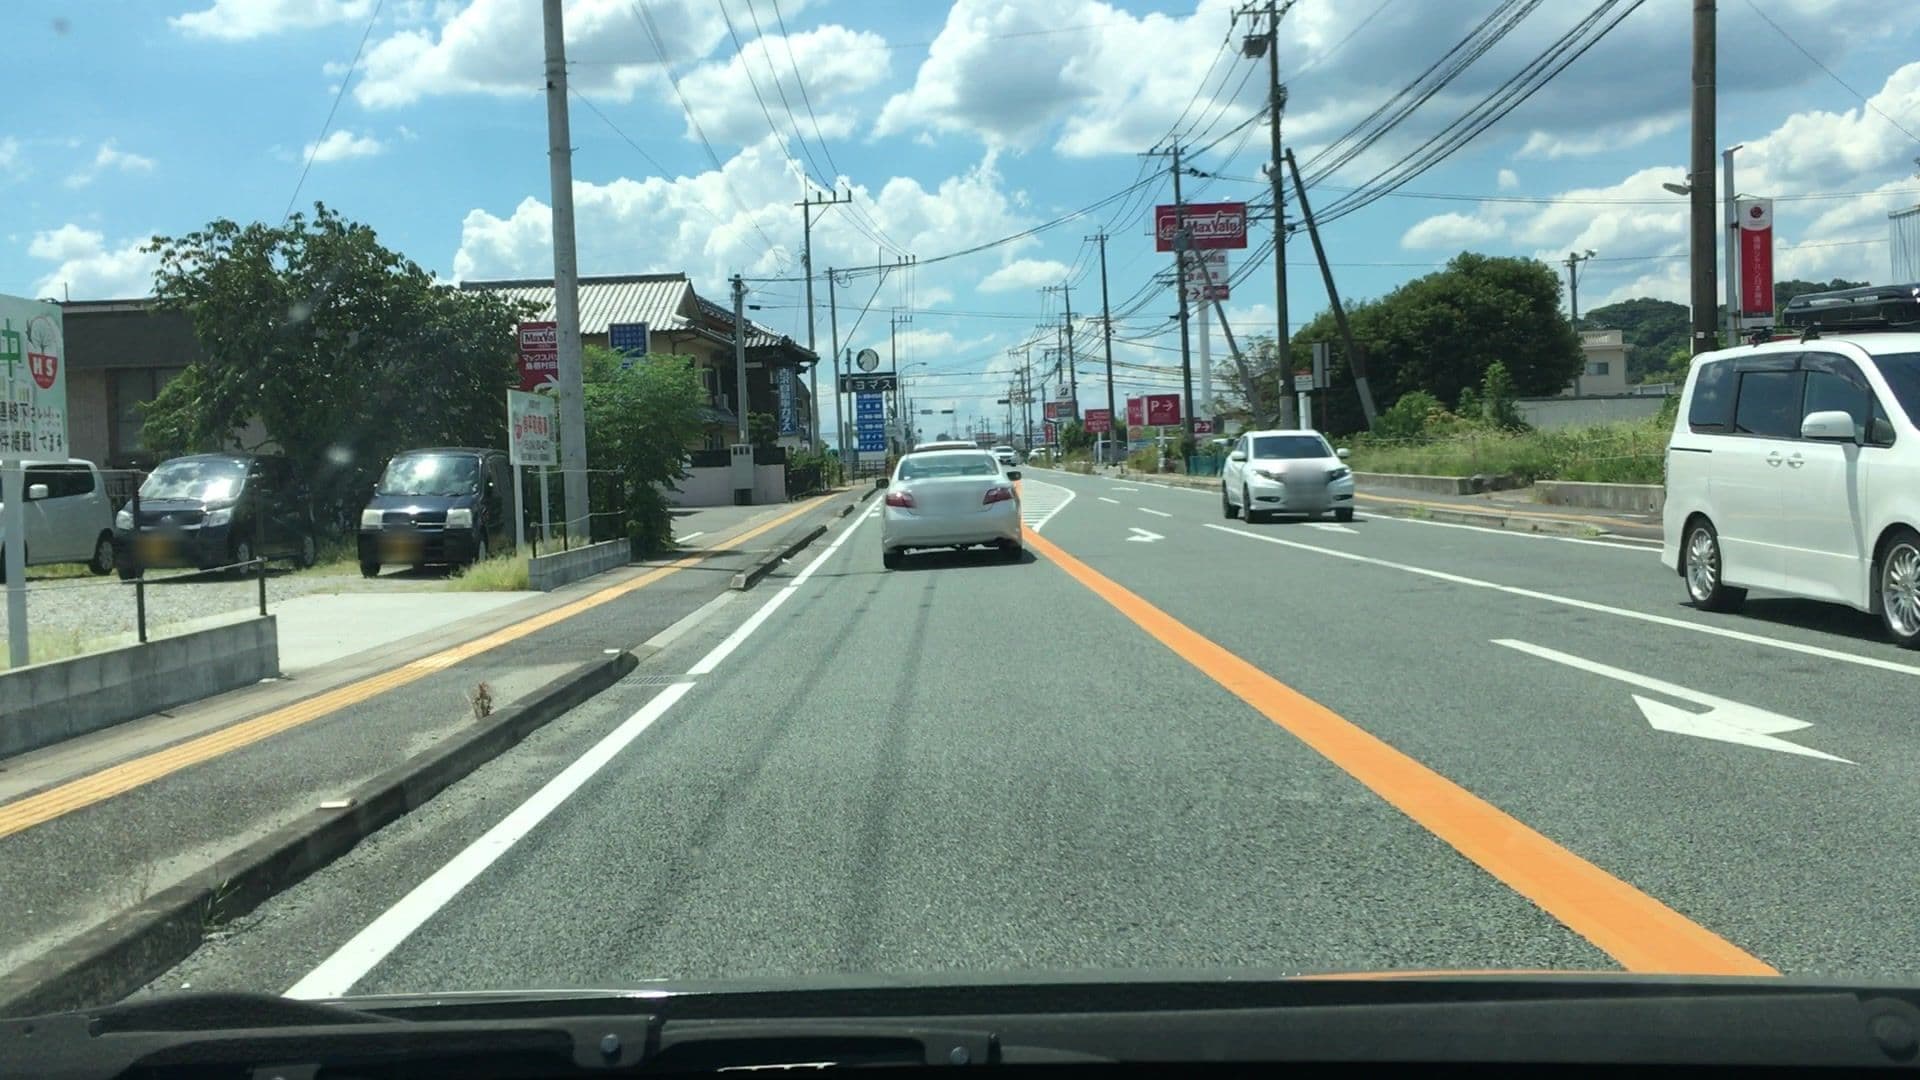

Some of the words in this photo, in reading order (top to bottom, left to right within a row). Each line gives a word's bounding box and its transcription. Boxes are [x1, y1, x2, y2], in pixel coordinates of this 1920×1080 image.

[524, 327, 556, 343] MaxVal
[851, 380, 892, 390] ヨマス
[1151, 400, 1160, 412] P
